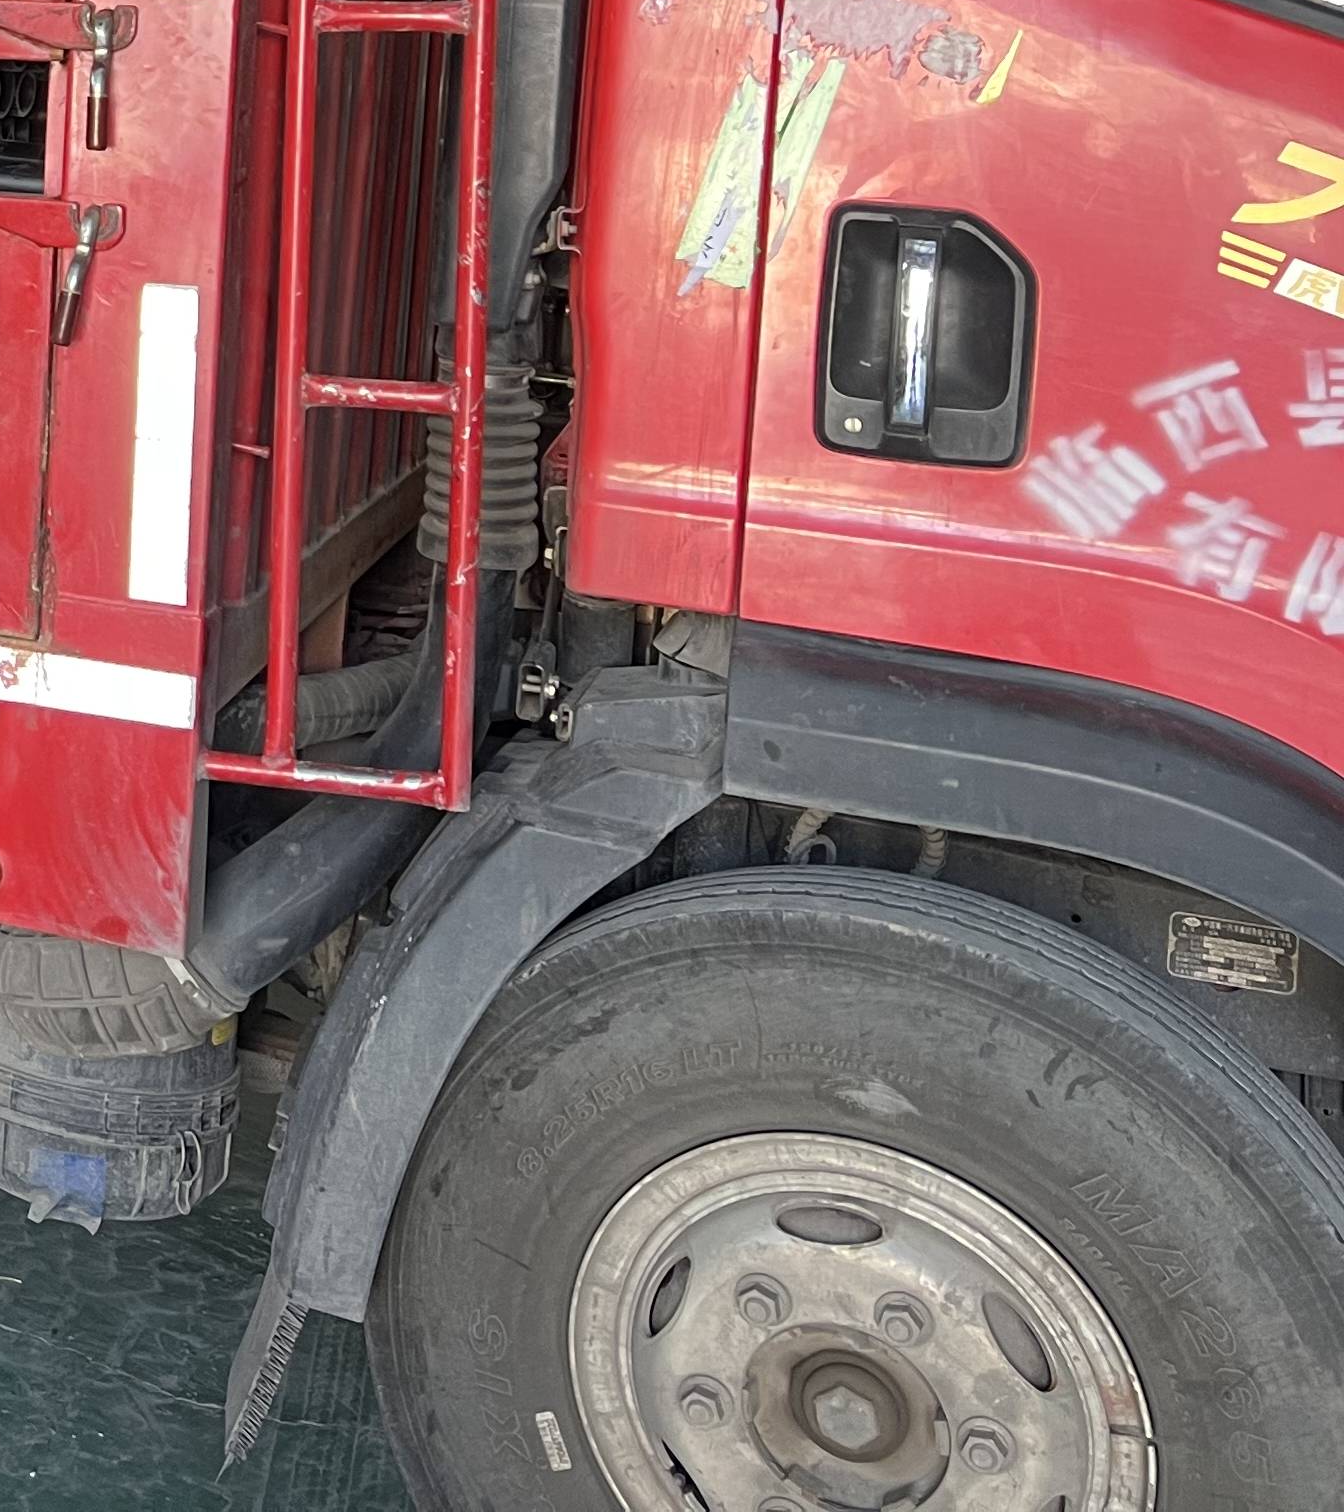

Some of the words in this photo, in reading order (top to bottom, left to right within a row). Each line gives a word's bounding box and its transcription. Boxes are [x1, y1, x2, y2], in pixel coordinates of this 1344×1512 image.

[1287, 271, 1344, 314] 虎
[681, 1039, 742, 1074] LT
[469, 1308, 548, 1496] XIS
